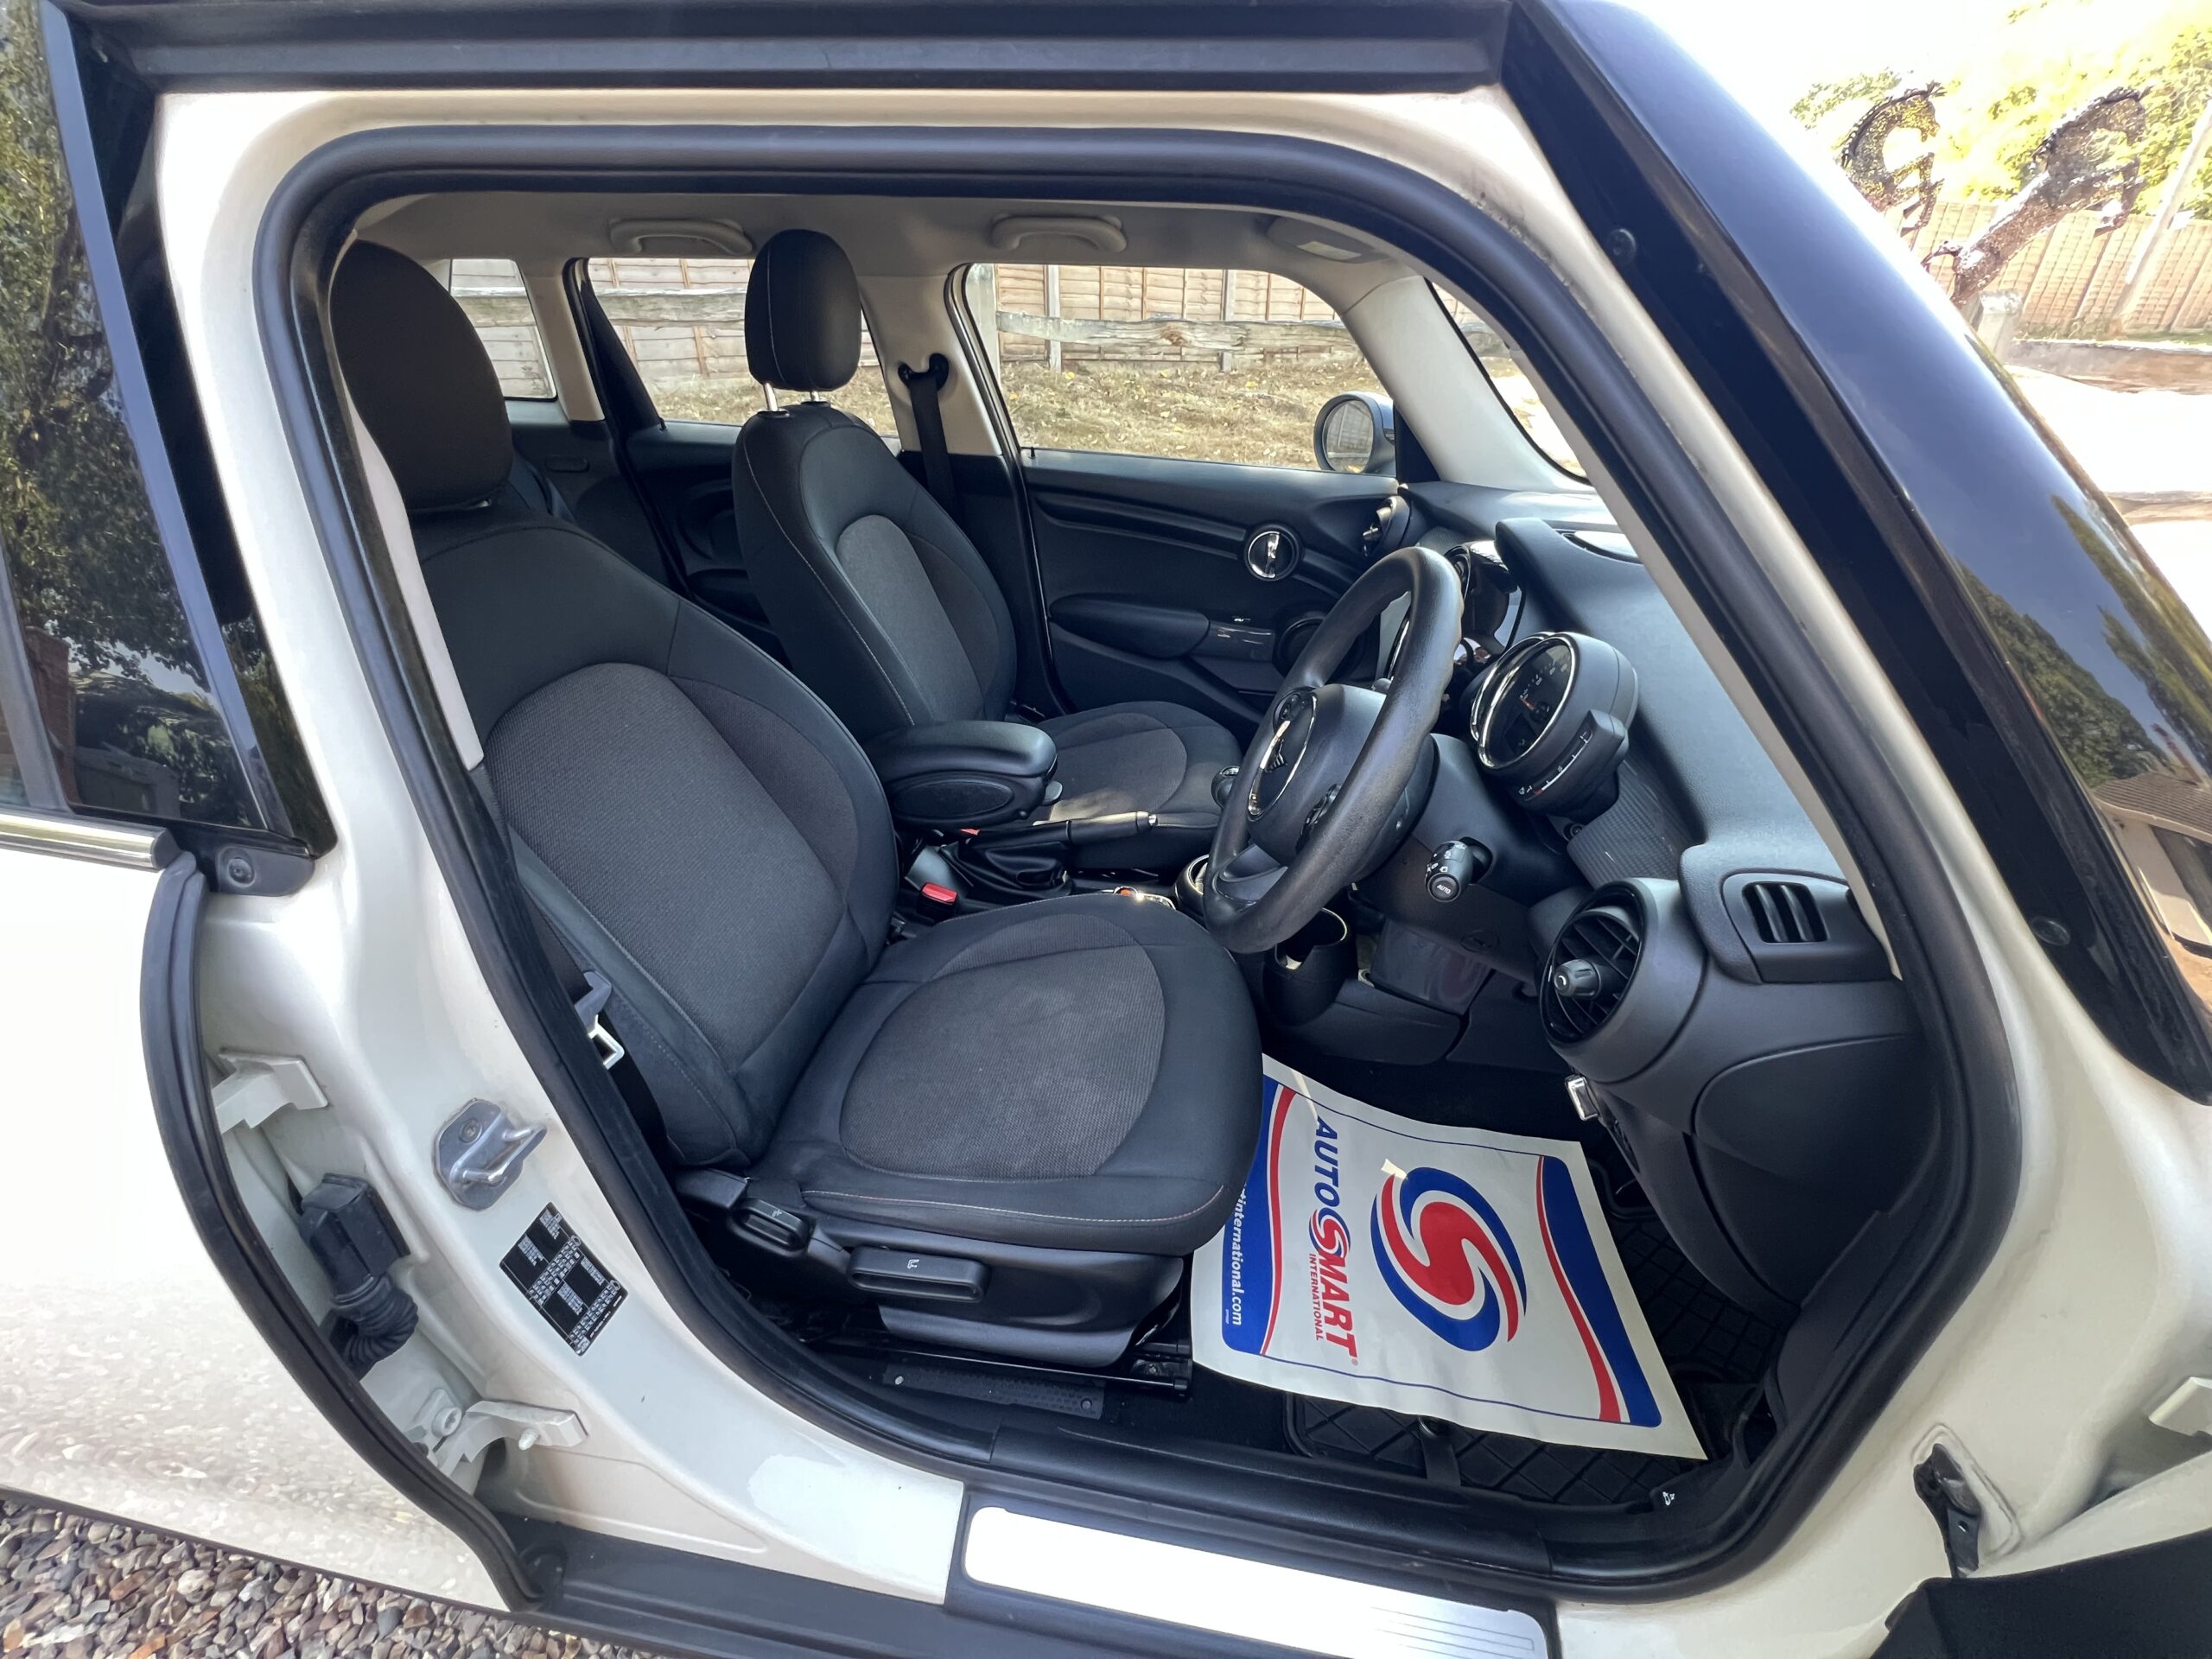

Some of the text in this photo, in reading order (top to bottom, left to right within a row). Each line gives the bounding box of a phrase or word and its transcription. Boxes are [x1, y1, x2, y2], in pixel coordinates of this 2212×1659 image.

[1437, 884, 1452, 894] AUTO
[1231, 1184, 1246, 1325] tinternational.com
[1309, 1254, 1324, 1341] INTERNATIONAL
